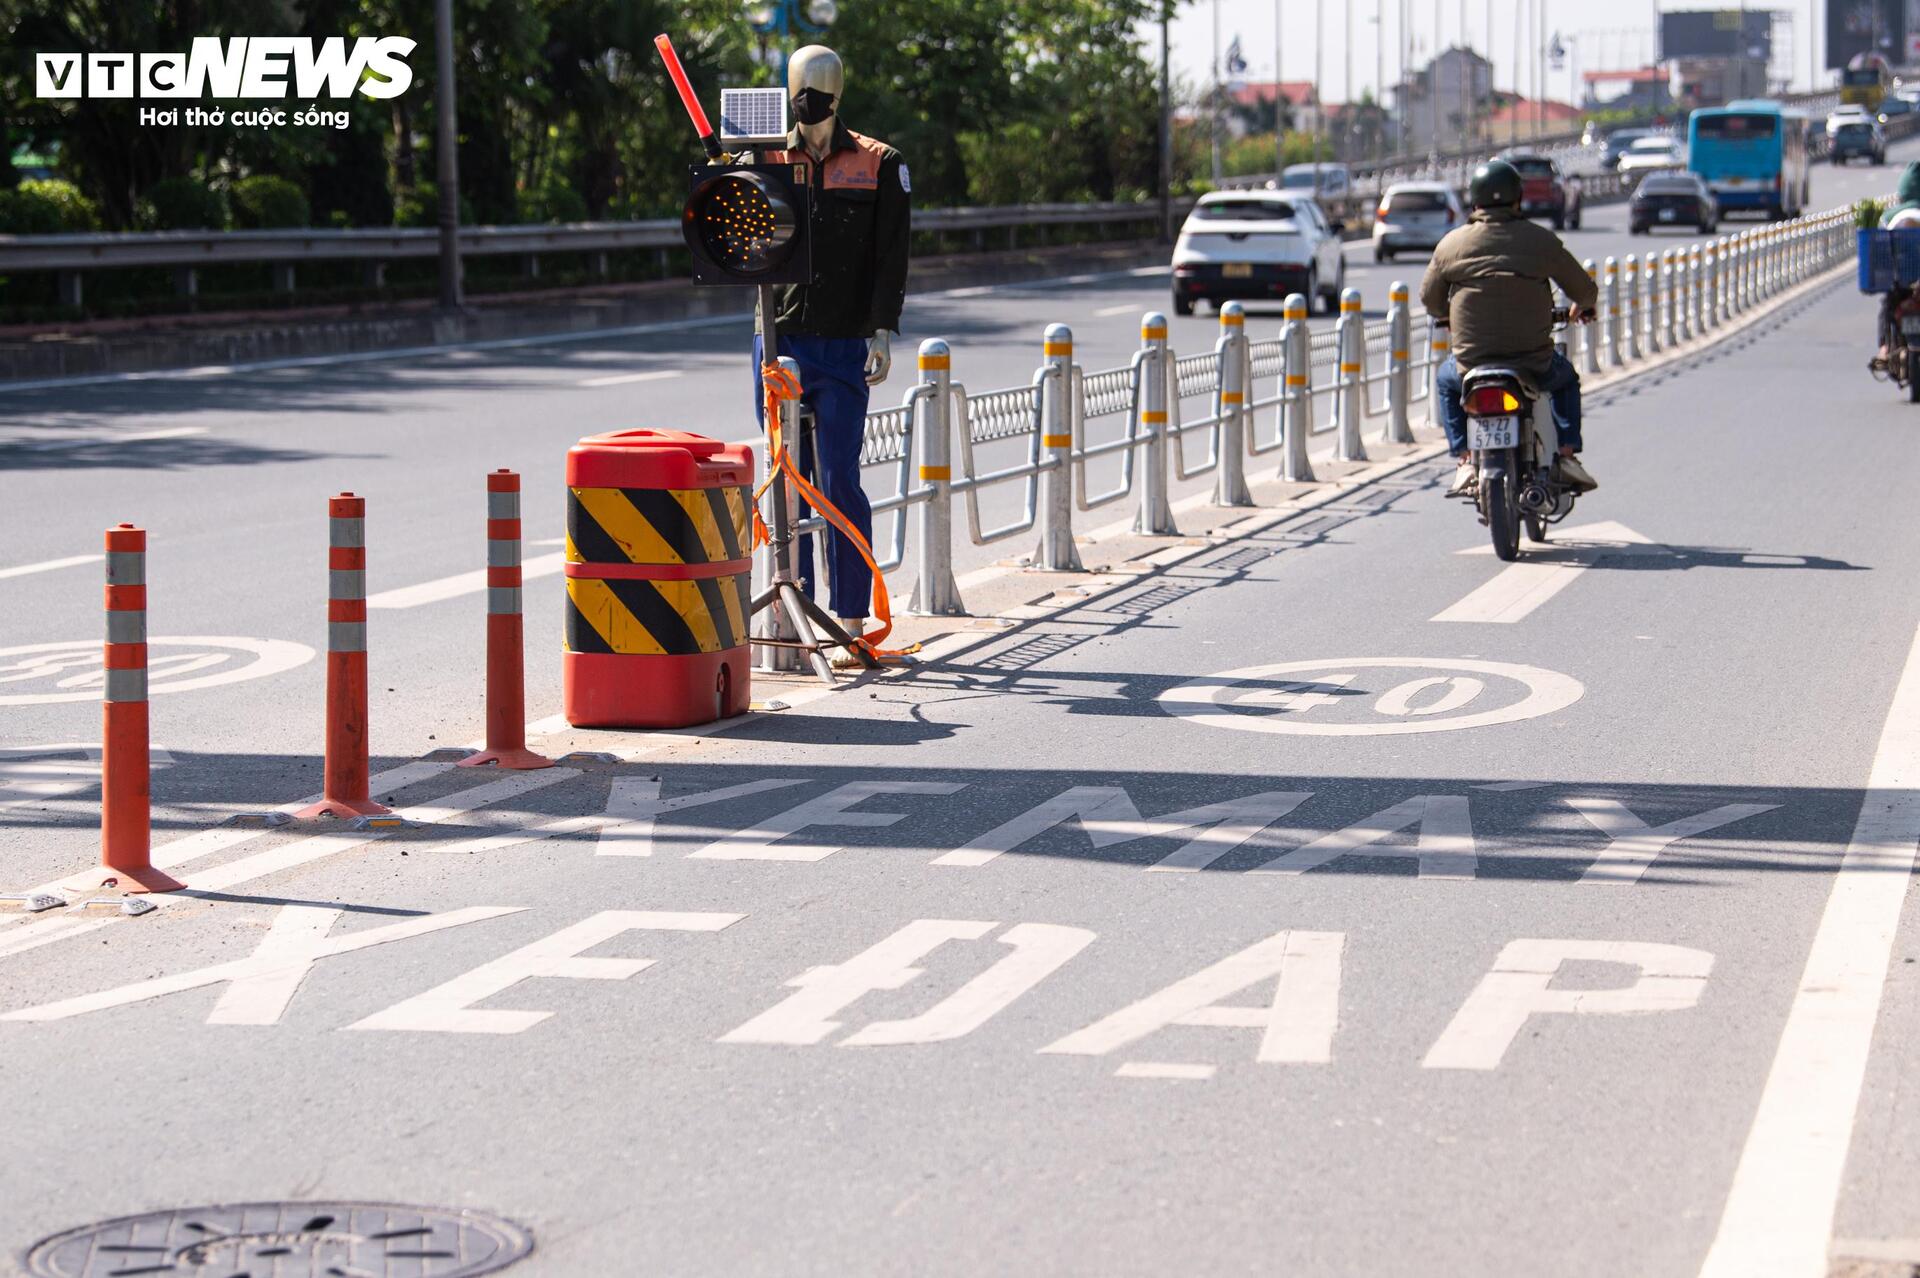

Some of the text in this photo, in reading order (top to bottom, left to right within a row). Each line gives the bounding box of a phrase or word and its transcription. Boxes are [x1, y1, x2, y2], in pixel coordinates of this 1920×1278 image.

[1475, 431, 1512, 448] 5768
[1233, 673, 1486, 716] 40
[425, 775, 972, 862] XE
[0, 904, 750, 1034] XE
